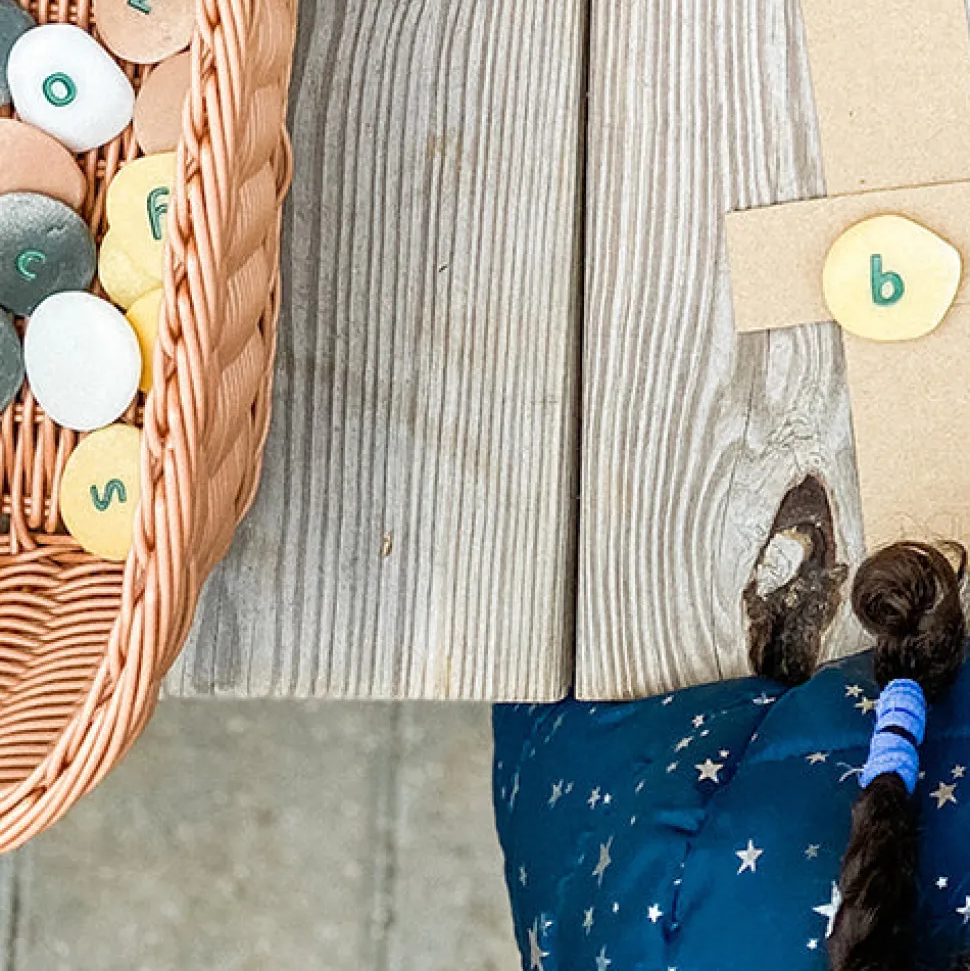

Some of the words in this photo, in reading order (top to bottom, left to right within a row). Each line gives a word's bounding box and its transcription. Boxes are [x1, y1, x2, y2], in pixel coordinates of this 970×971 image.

[41, 70, 79, 108] o
[14, 248, 47, 280] c
[869, 253, 906, 307] b
[89, 477, 128, 512] s
